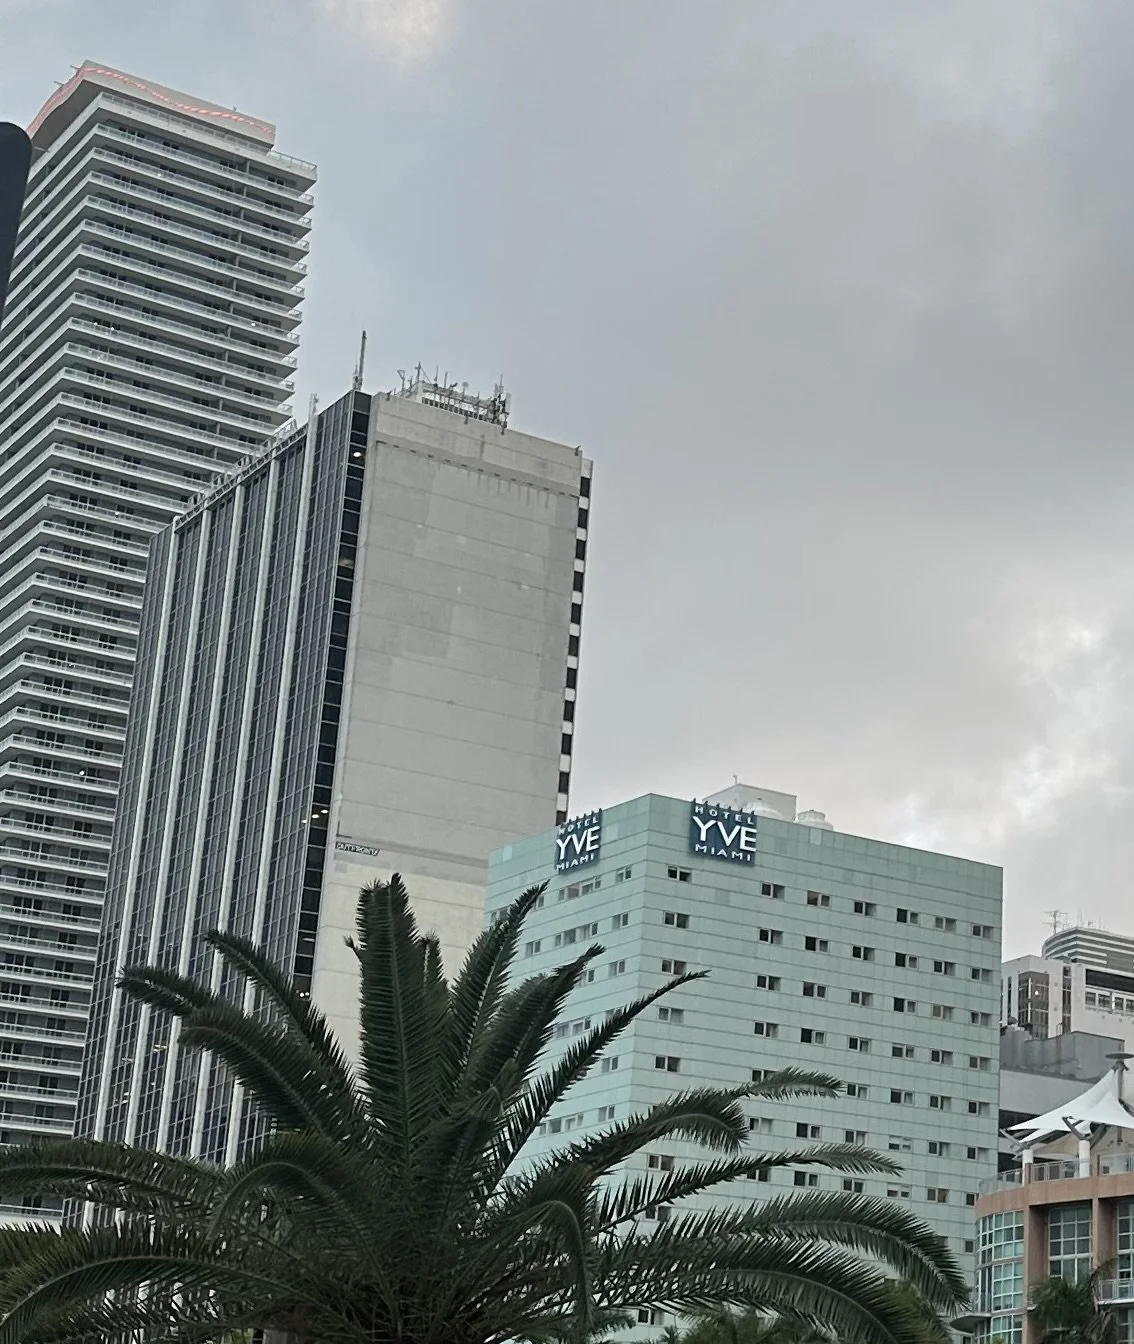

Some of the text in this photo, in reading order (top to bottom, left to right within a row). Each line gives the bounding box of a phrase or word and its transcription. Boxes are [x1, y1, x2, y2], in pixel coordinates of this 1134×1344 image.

[695, 805, 755, 825] HOTEL
[558, 816, 599, 835] HOTEL
[692, 815, 757, 852] YVE
[555, 825, 600, 860] YVE
[695, 843, 751, 861] MIAMI
[555, 852, 595, 871] MIAMI
